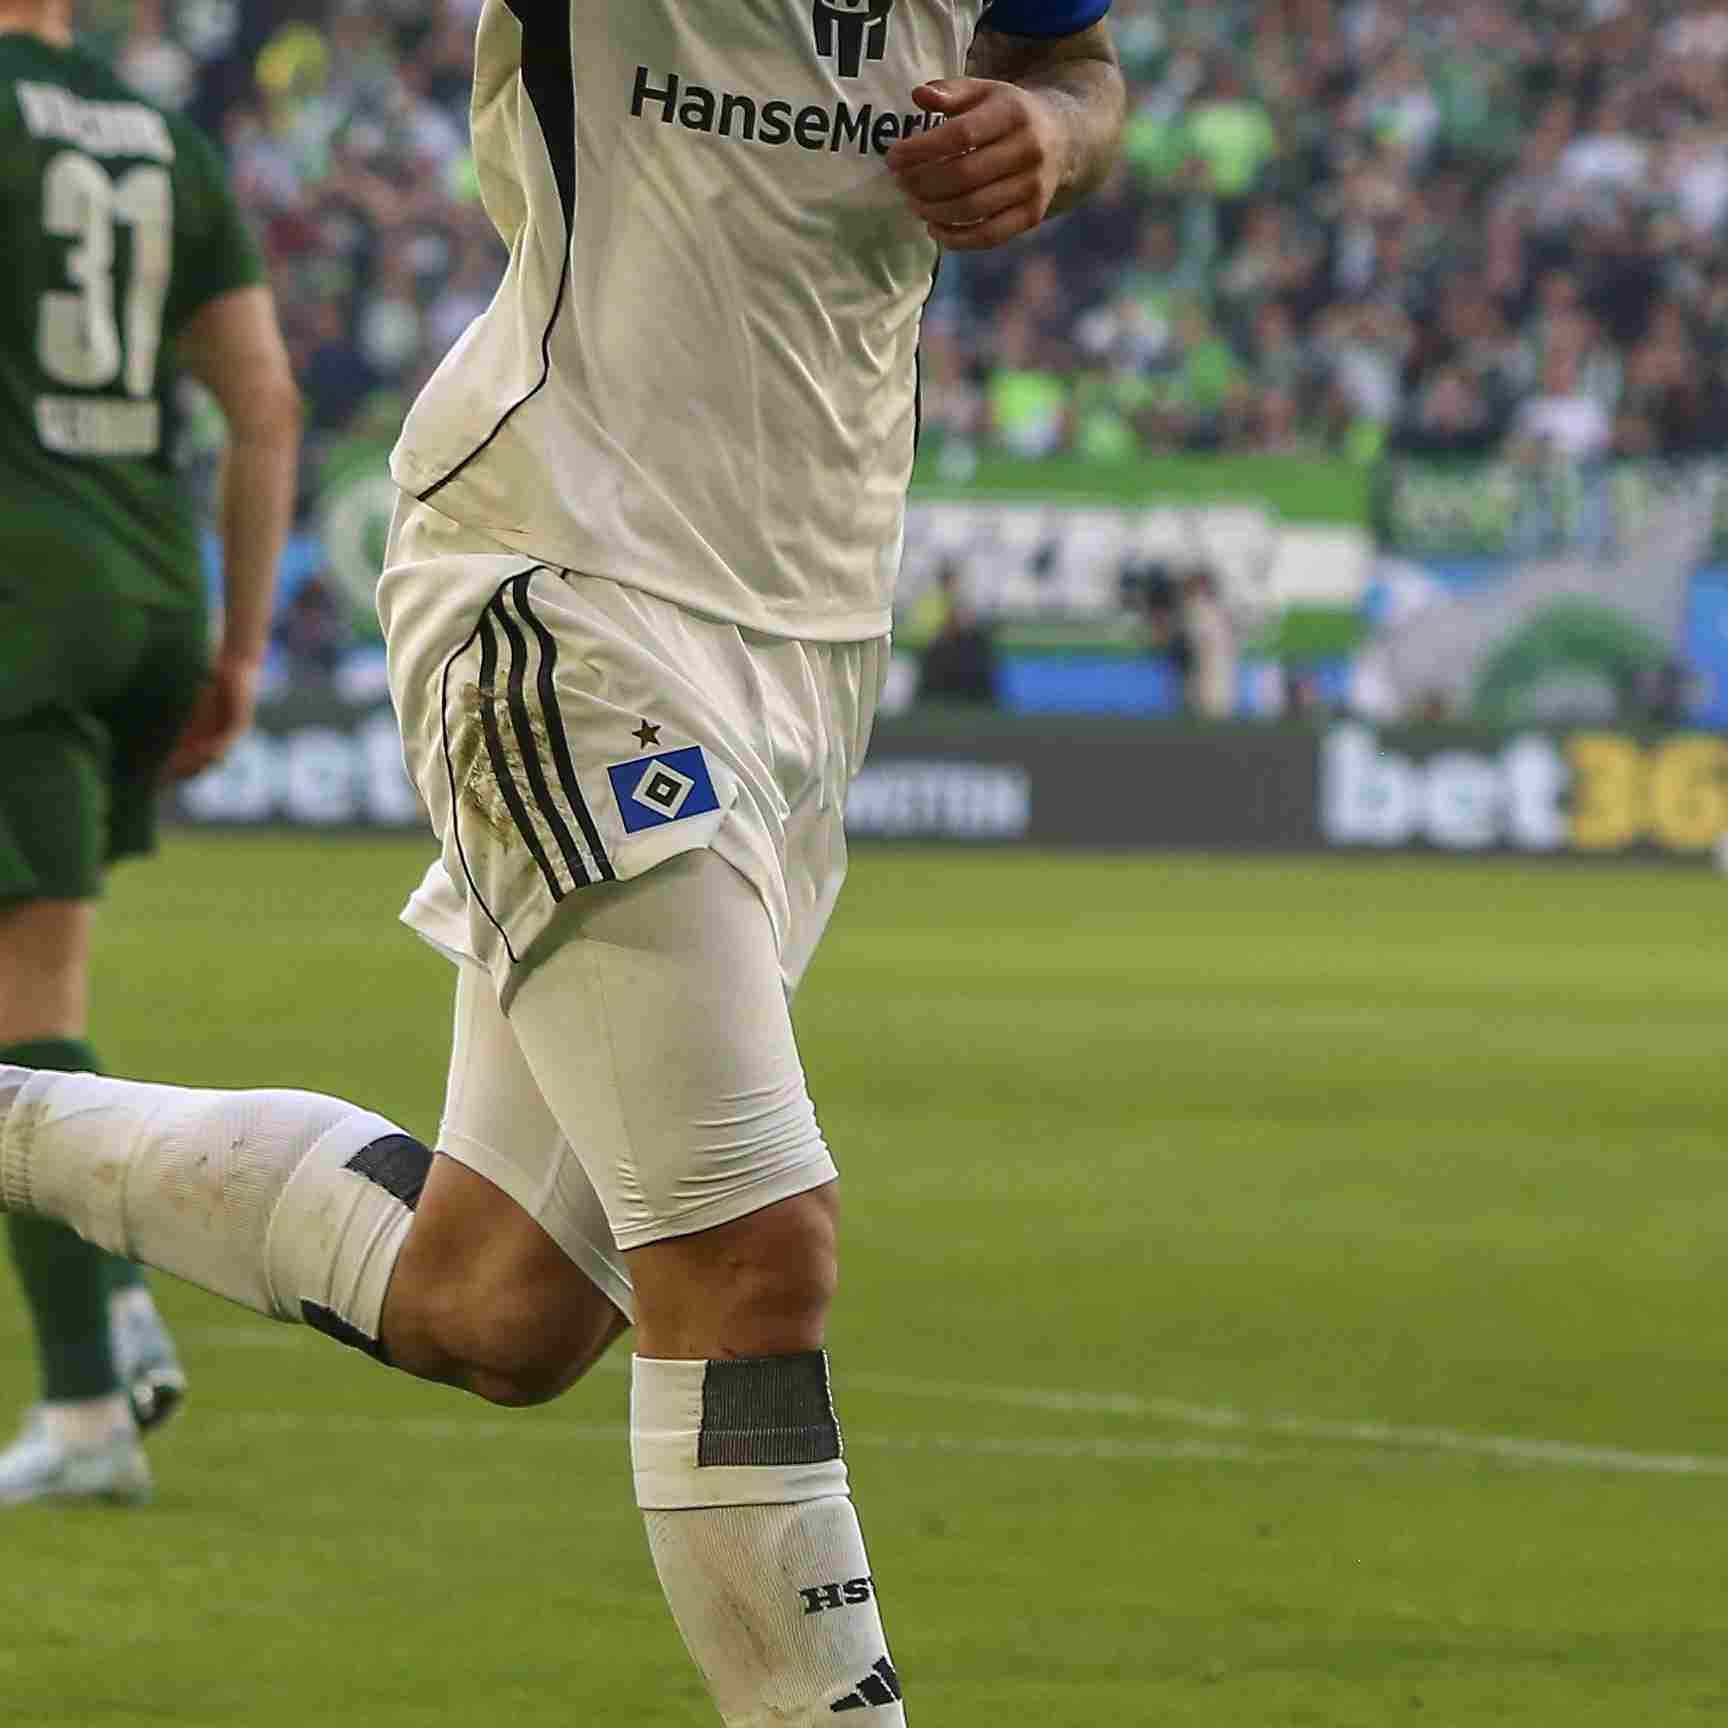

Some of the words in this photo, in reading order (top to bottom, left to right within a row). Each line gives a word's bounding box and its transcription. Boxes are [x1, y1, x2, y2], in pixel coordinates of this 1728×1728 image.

[630, 64, 944, 156] HanseMer
[36, 149, 175, 398] 31
[800, 1576, 876, 1616] HS
